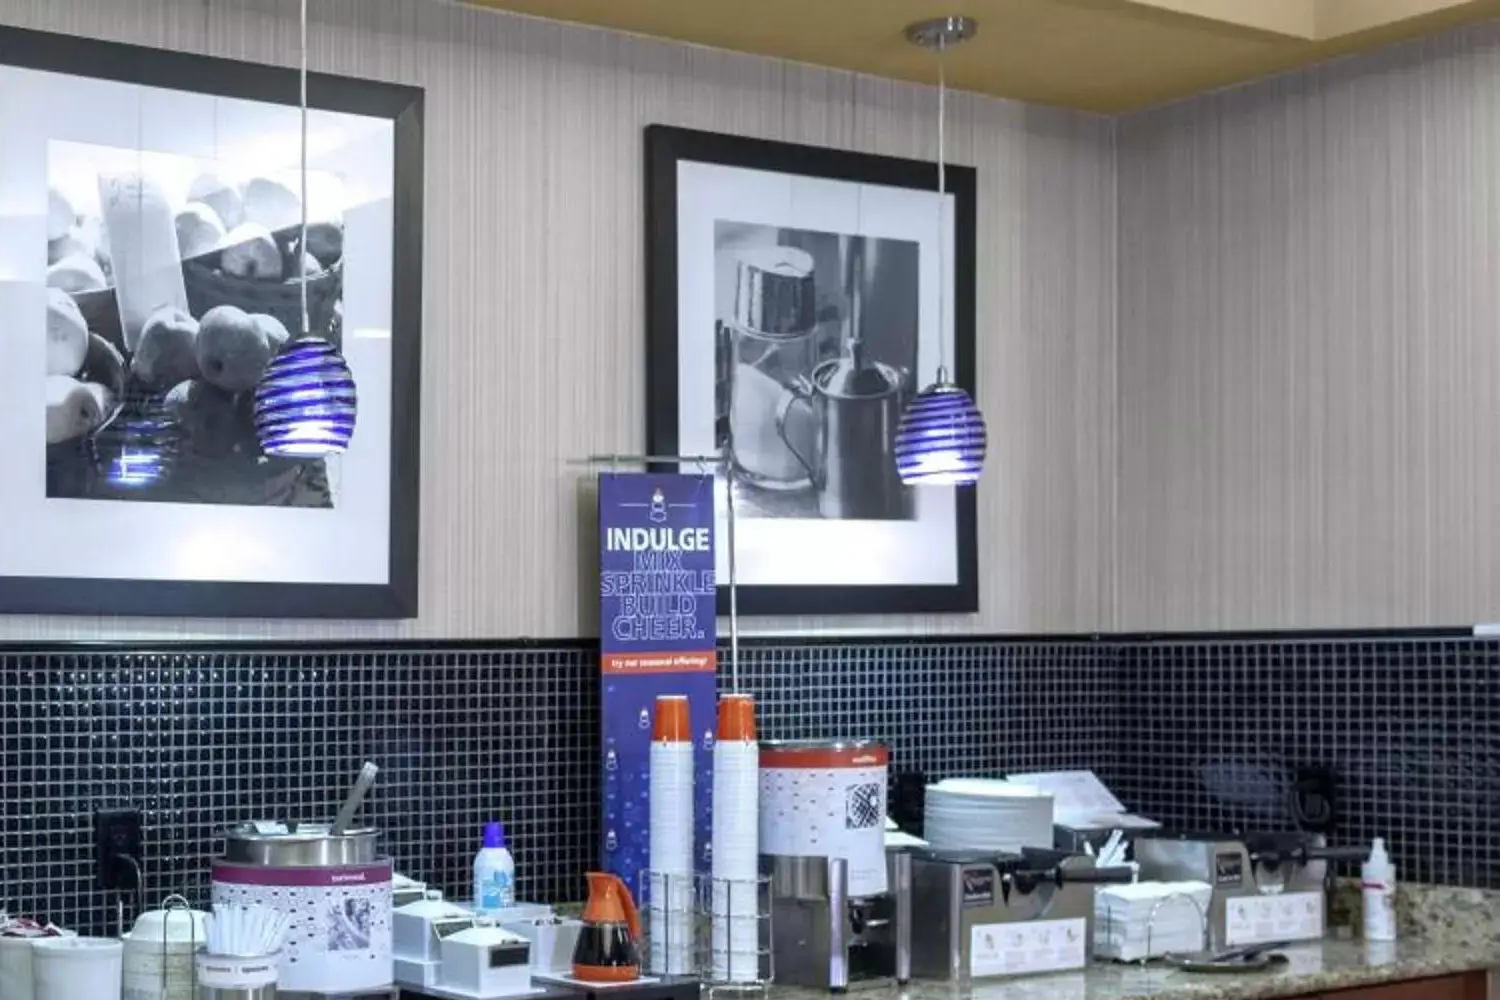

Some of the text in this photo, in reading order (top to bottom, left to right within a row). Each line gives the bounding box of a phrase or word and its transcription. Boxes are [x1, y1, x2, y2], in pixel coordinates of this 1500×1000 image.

[606, 527, 710, 551] INDULGE
[633, 549, 684, 573] MIX
[600, 570, 716, 597] SPRINKLE
[619, 594, 697, 618] BUILD
[611, 615, 705, 641] CHEER.
